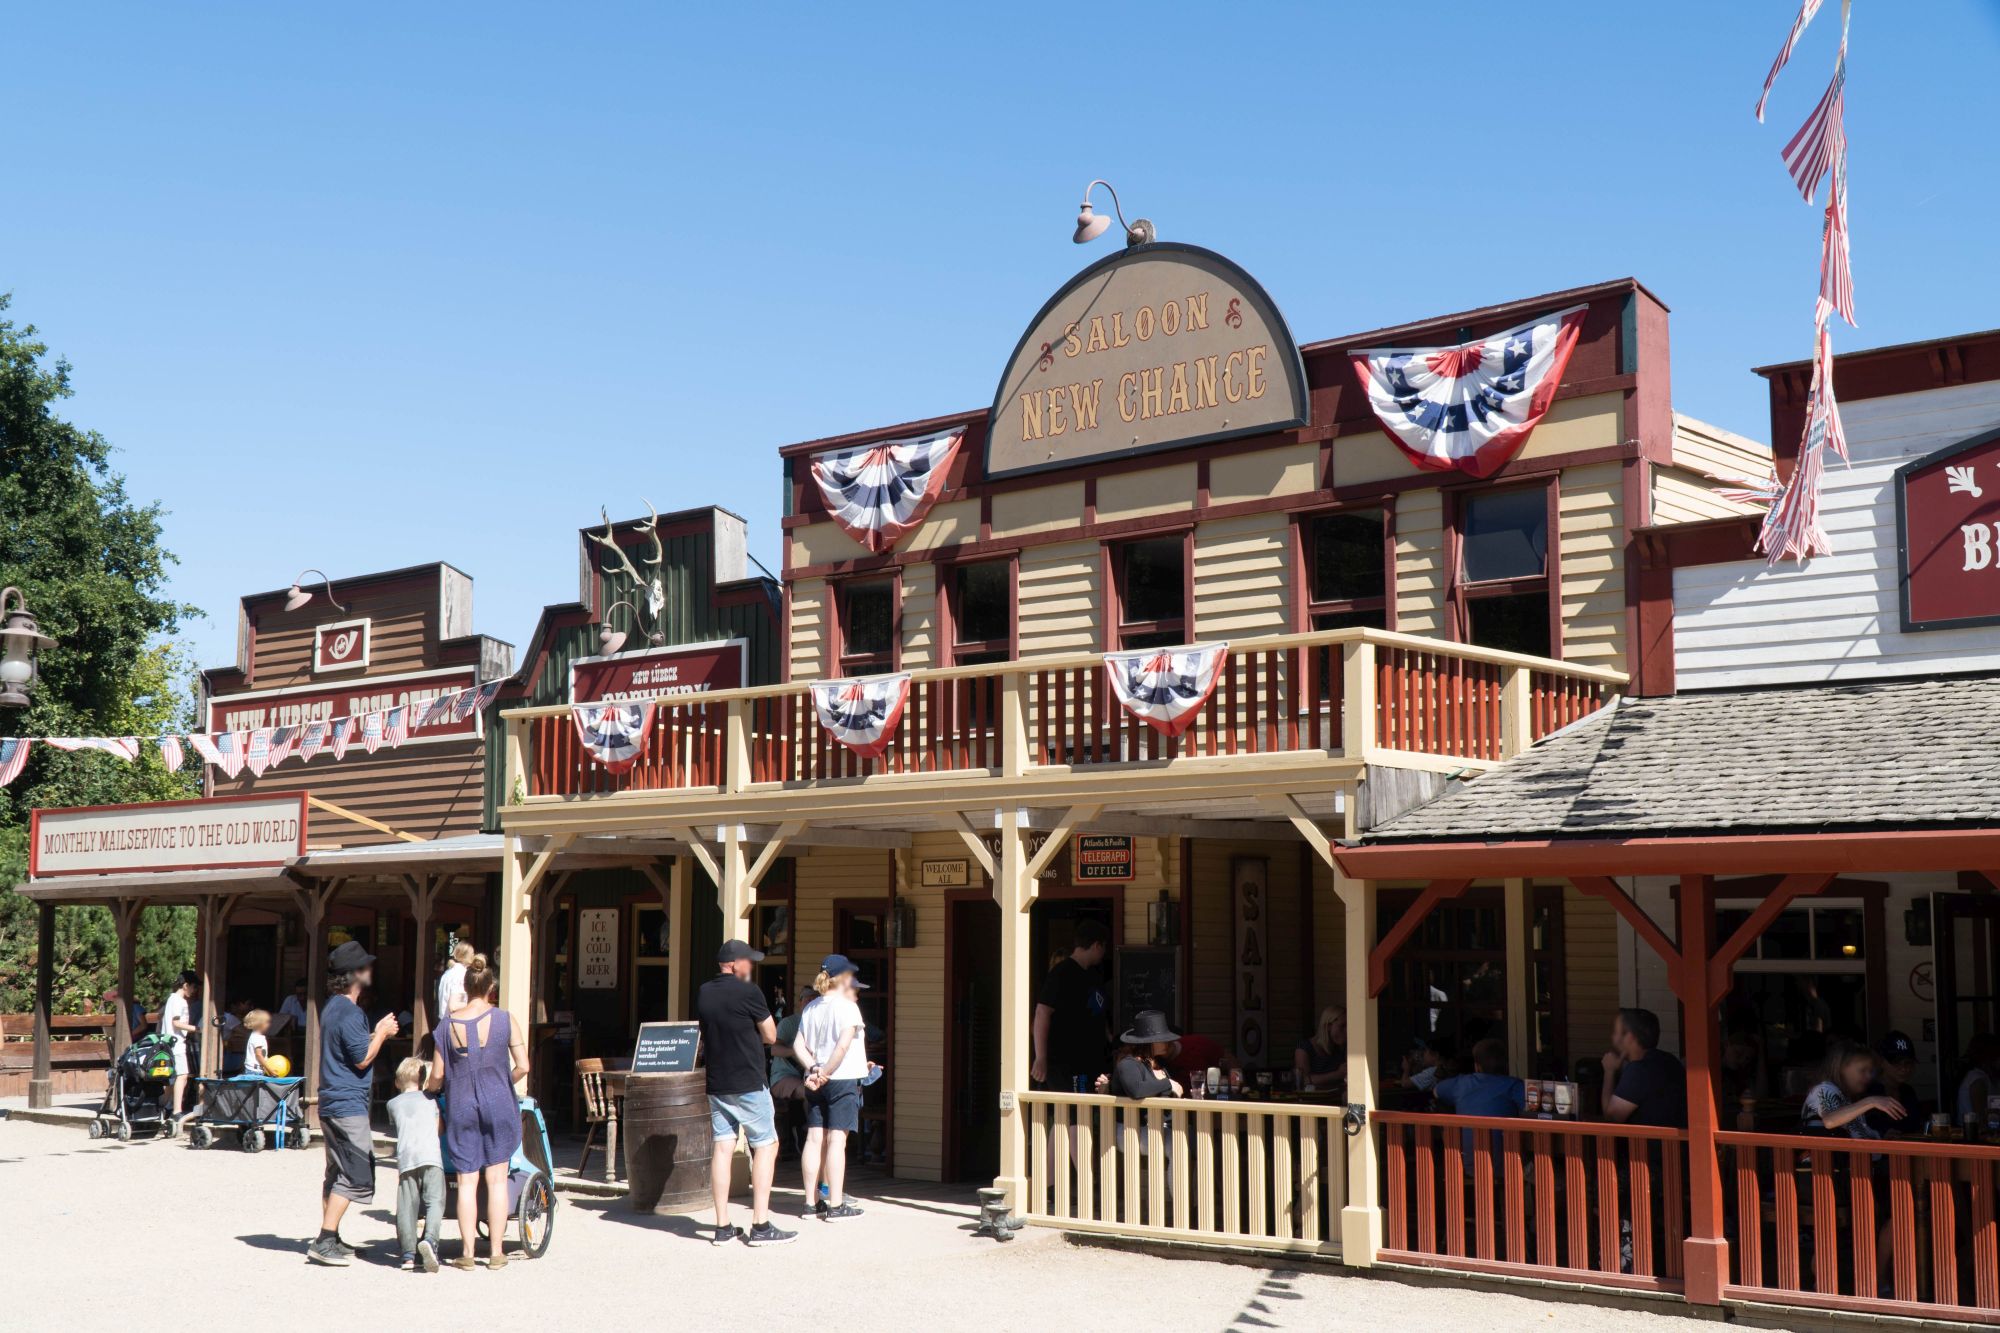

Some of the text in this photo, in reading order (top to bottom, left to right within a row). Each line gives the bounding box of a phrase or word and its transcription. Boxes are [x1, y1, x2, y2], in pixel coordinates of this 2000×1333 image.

[1063, 292, 1209, 358] SALOON
[1020, 345, 1267, 442] NEW CHANCE
[632, 663, 678, 685] NEW LÜBECK
[44, 818, 298, 855] MONTHLY MAILSERVICE TO THE OLD WORLD
[1104, 838, 1109, 847] &
[1083, 851, 1126, 863] TELEGRAPH
[925, 863, 964, 873] WELCOME
[938, 874, 953, 884] ALL
[591, 921, 607, 933] ICE
[586, 942, 611, 954] COLD
[586, 964, 610, 976] BEER
[655, 1045, 676, 1053] platziert
